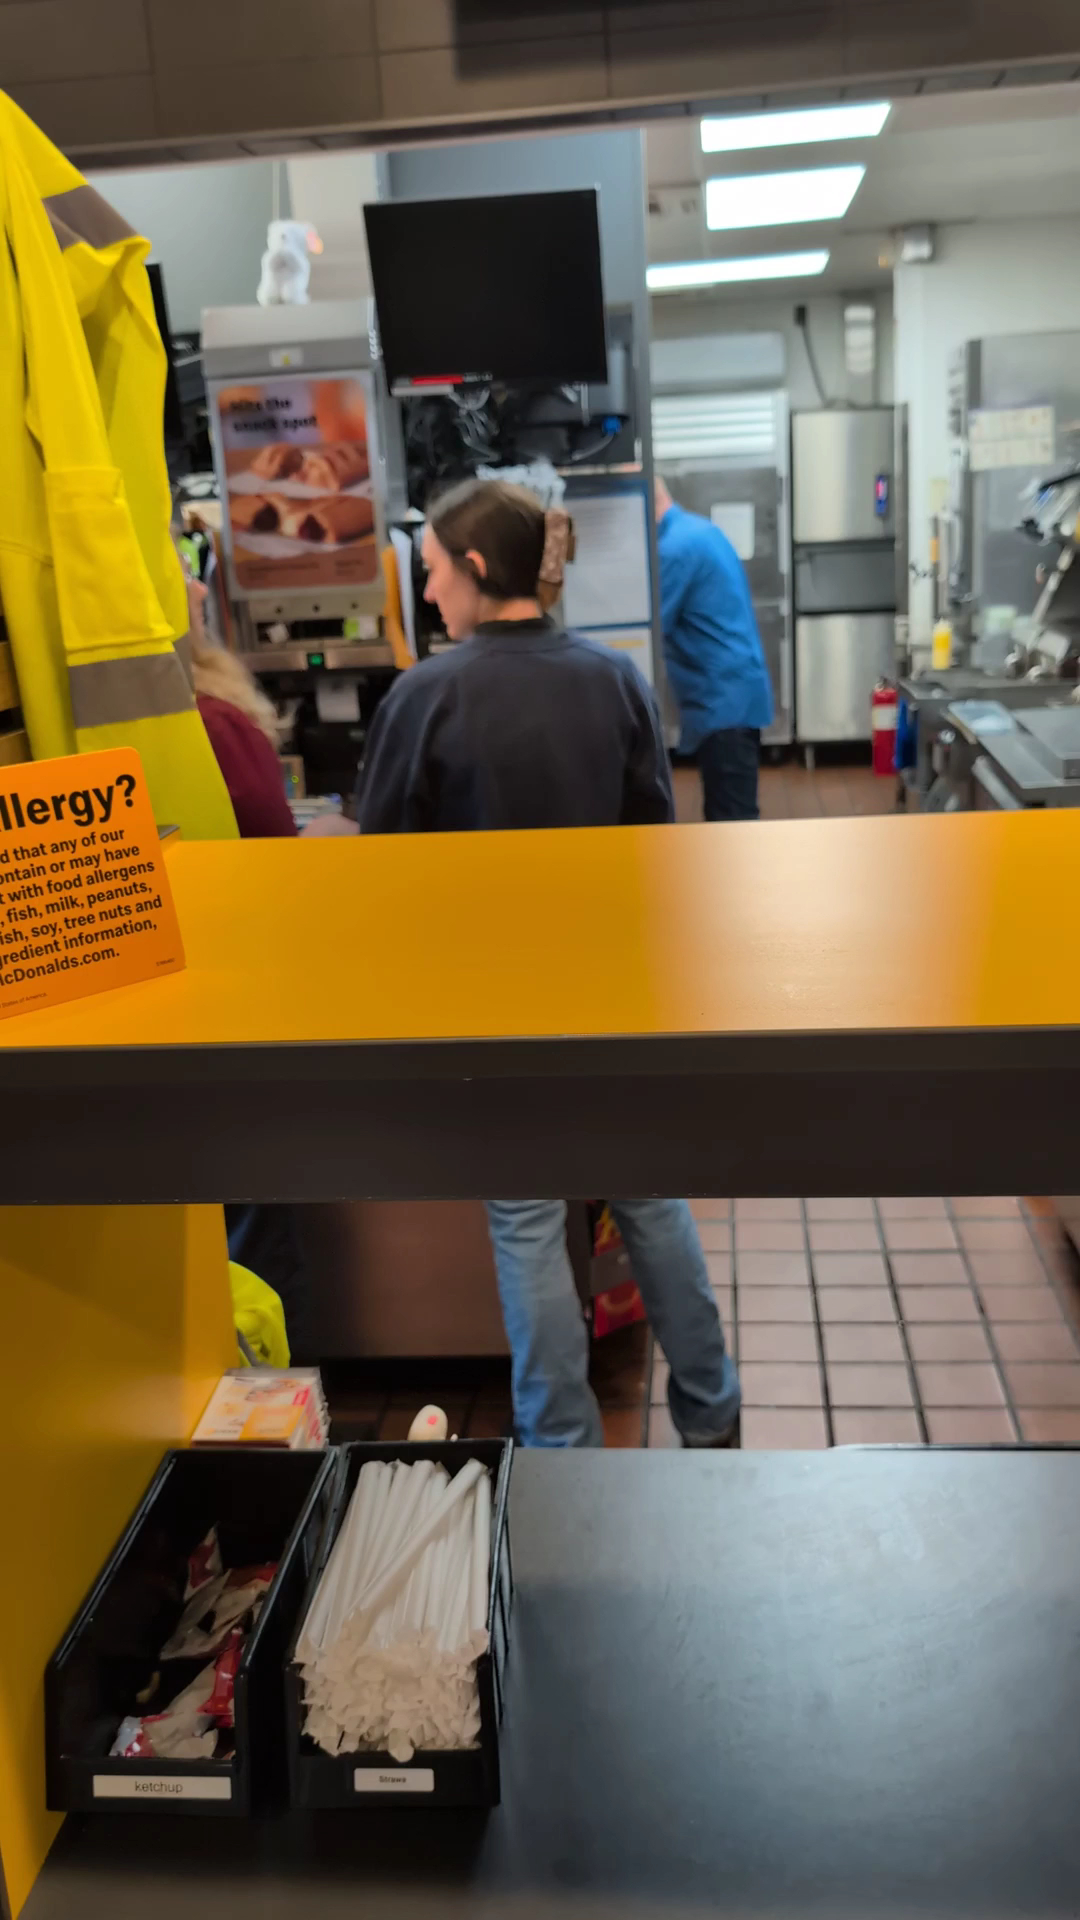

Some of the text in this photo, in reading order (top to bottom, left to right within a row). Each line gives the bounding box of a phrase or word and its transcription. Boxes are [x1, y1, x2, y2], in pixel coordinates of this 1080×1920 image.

[0, 774, 136, 832] llergy?
[13, 843, 48, 861] that
[51, 839, 77, 853] any
[81, 832, 97, 847] of
[100, 829, 125, 843] our
[50, 860, 66, 873] or
[70, 853, 100, 869] may
[104, 846, 140, 862] have
[8, 883, 44, 902] with
[47, 874, 83, 894] food
[86, 861, 155, 885] allergens
[6, 881, 152, 923] fish, milk, peanuts,
[31, 922, 62, 938] soy,
[64, 914, 96, 929] tree
[98, 903, 132, 922] nuts
[136, 895, 163, 913] and
[64, 918, 157, 950] information,
[135, 1781, 183, 1794] ketchup
